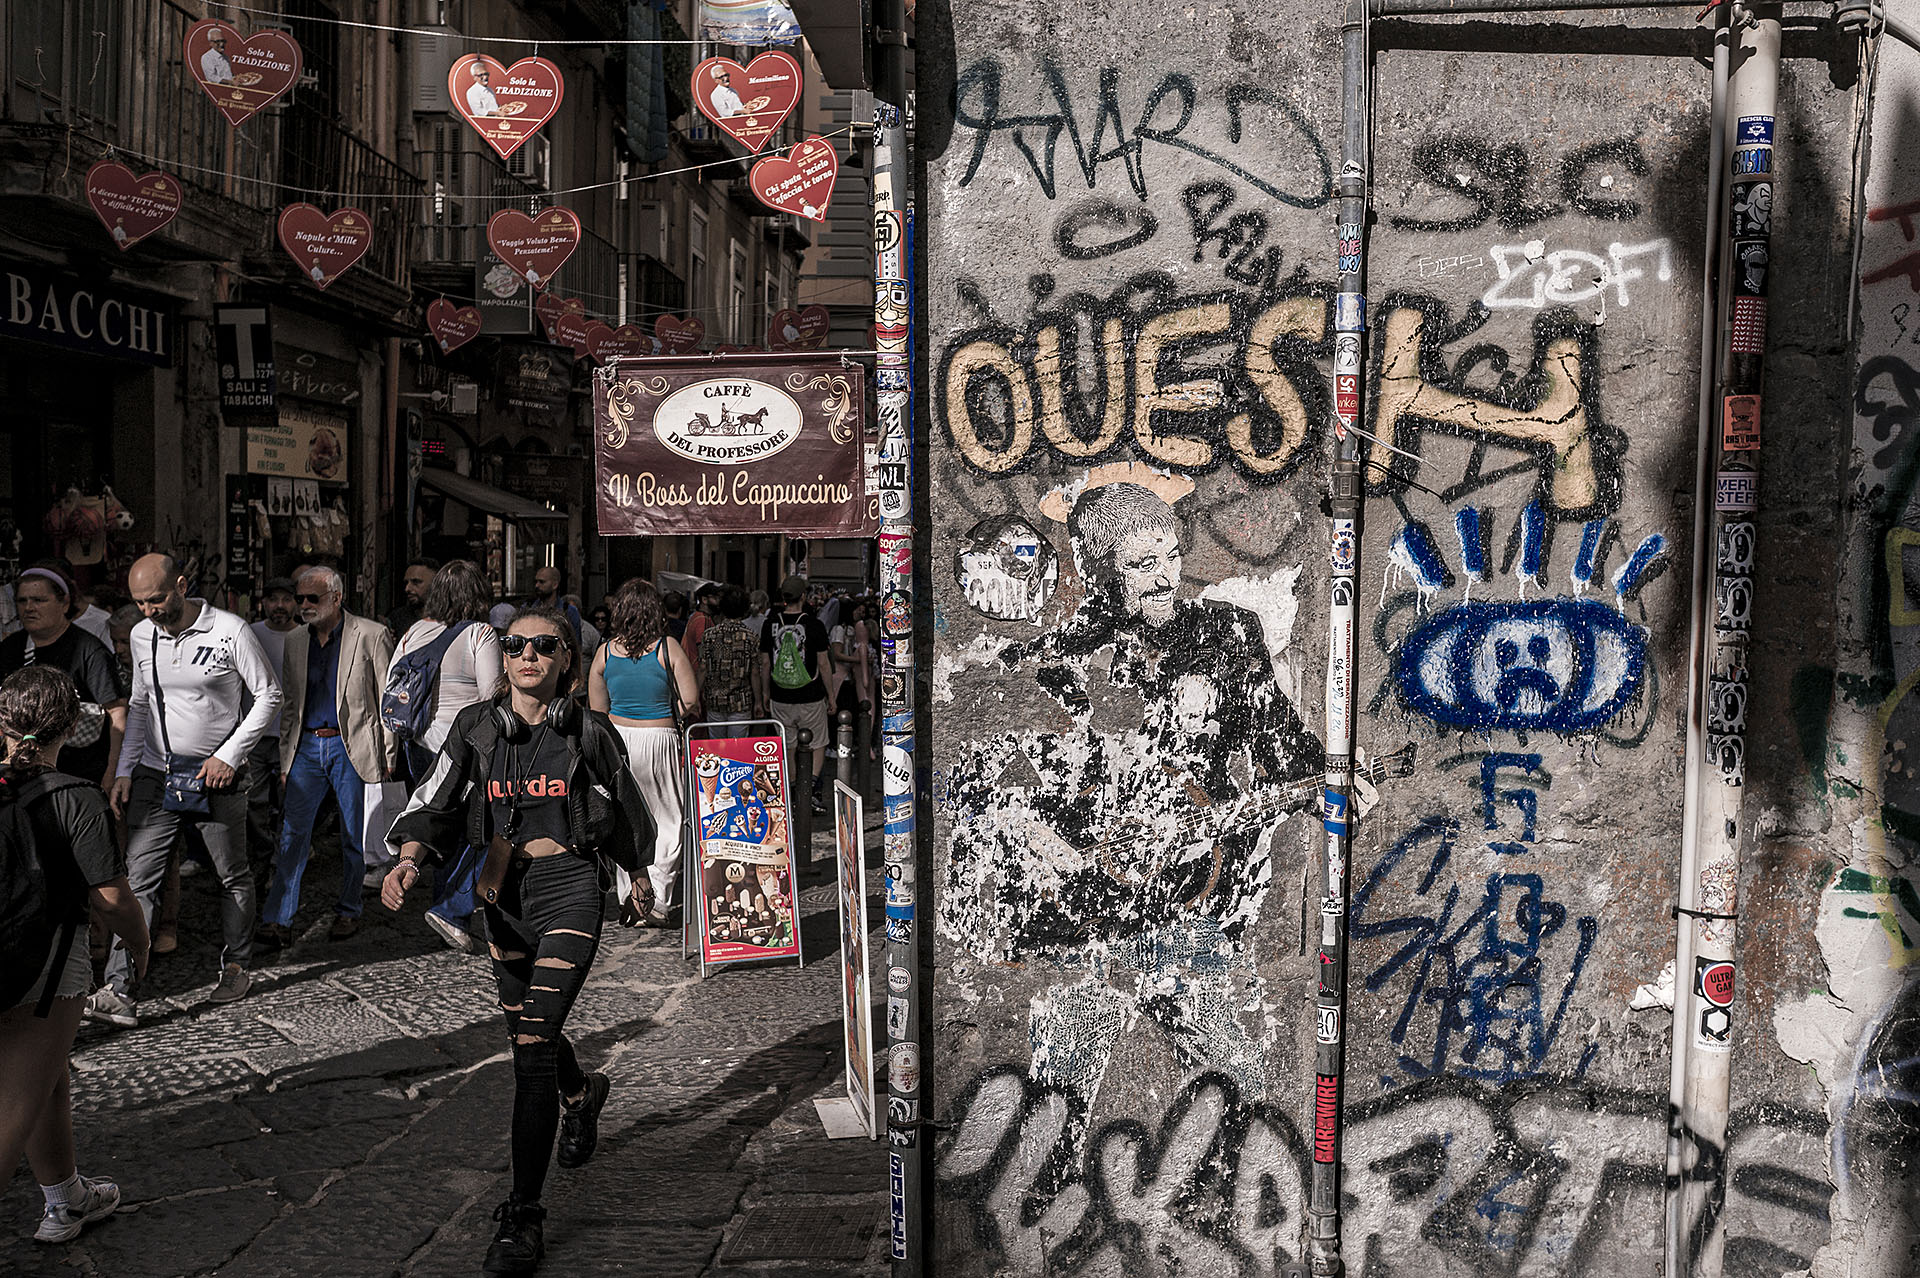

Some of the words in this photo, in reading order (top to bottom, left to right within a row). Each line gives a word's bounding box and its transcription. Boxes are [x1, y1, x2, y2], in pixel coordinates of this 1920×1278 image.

[247, 47, 265, 57] Solo
[267, 50, 275, 59] la
[231, 55, 291, 72] TRADIZIONE
[510, 77, 526, 86] Solo
[528, 78, 536, 86] la
[495, 86, 553, 98] TRADIZIONE
[765, 184, 779, 197] Chi
[780, 174, 802, 190] sputa
[802, 159, 829, 176] 'ncielo
[771, 186, 803, 205] 'nfaccia
[803, 180, 811, 190] le
[812, 169, 834, 184] torna
[108, 200, 135, 212] difficile
[295, 231, 325, 243] Napule
[307, 244, 344, 256] Culure...
[0, 272, 166, 356] BACCHI
[218, 308, 266, 380] T
[226, 382, 256, 393] SALI
[703, 383, 752, 399] CAFFÈ
[223, 395, 273, 406] TABACCHI
[666, 431, 694, 453] DEL
[697, 429, 789, 459] PROFESSORE
[608, 473, 633, 507] Il
[637, 471, 692, 506] Boss
[692, 472, 728, 506] del
[732, 470, 853, 521] Cappuccino
[720, 766, 753, 787] Cornetto
